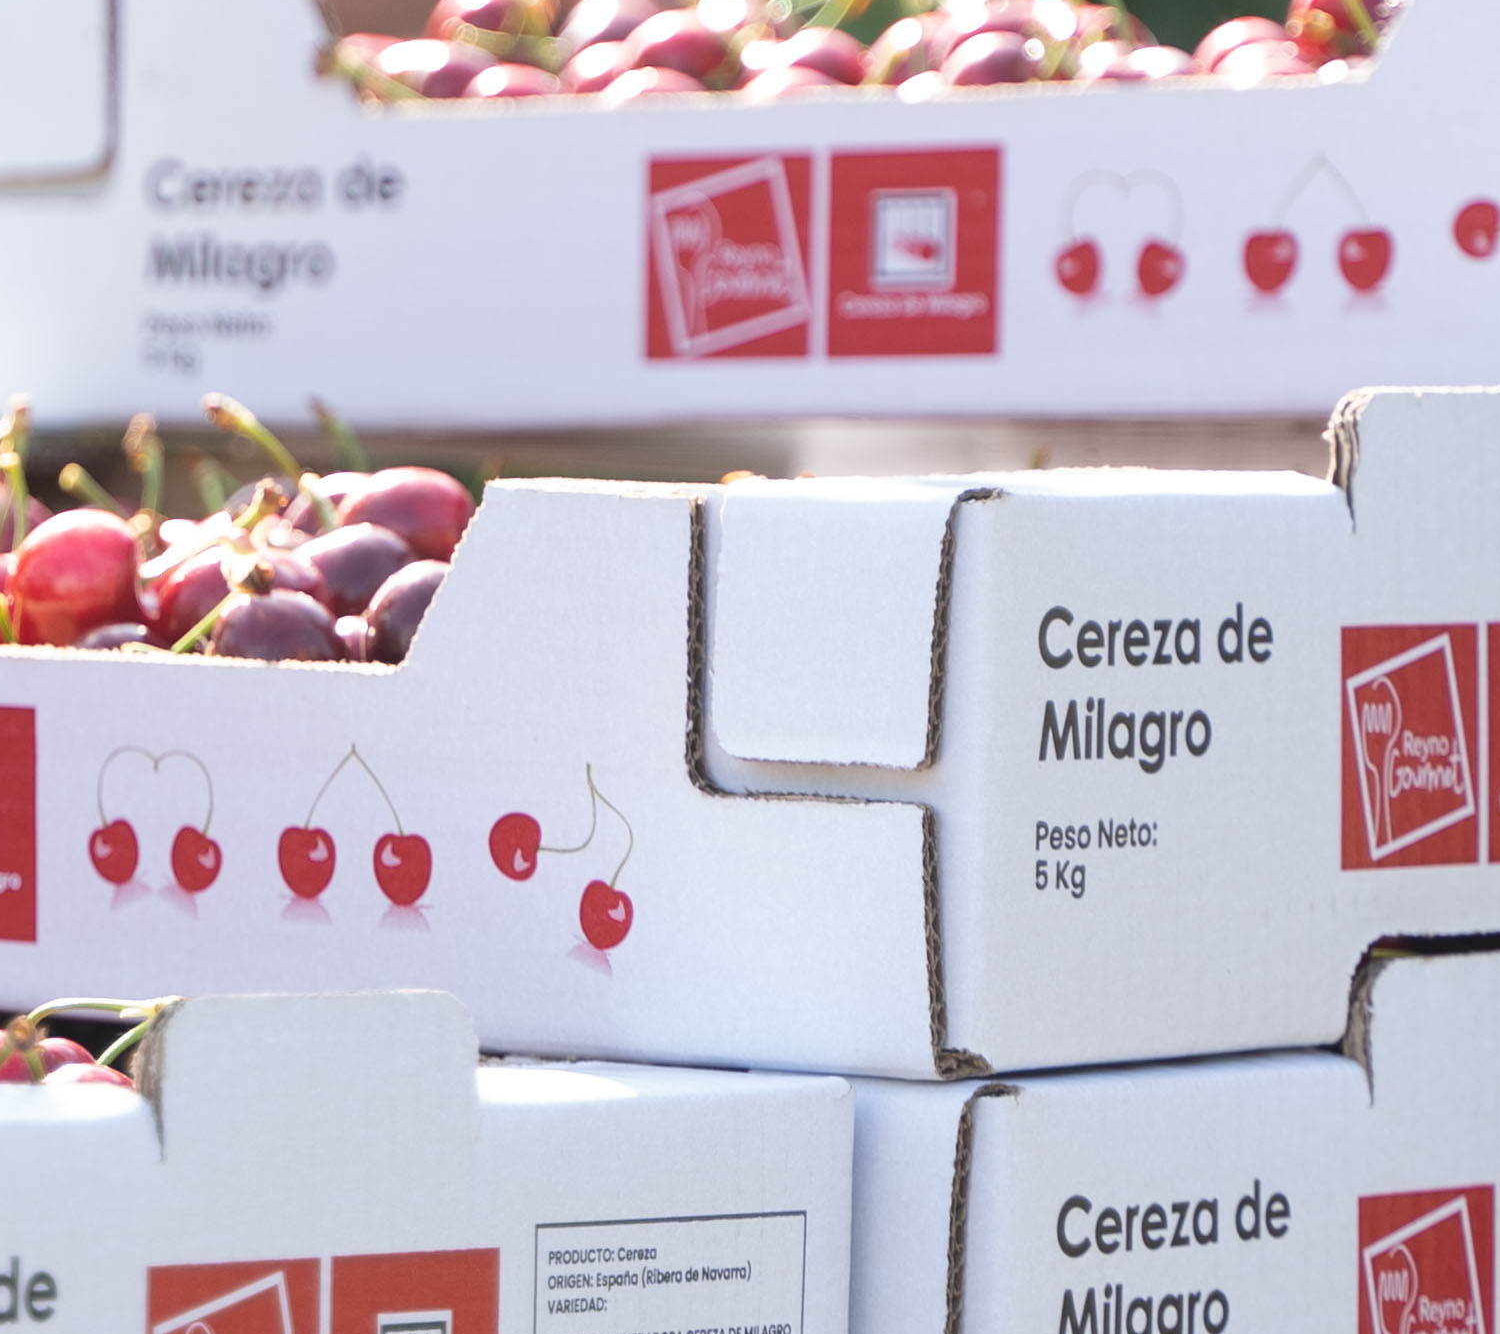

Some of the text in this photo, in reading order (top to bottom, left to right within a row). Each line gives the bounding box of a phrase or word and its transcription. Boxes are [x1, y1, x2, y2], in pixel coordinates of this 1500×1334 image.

[1038, 601, 1273, 669] Cereza de
[1038, 696, 1211, 774] Milagro
[1402, 729, 1449, 763] Reyno
[1035, 818, 1157, 850] Peso Neto:
[1035, 859, 1085, 898] 5 Kg
[1057, 1178, 1291, 1258] Cereza de
[549, 1247, 656, 1265] PRODUCTO: Cereza
[548, 1260, 751, 1291] ORIGEN: España (Ribera de Navarra)
[548, 1298, 608, 1315] VARIEDAD:
